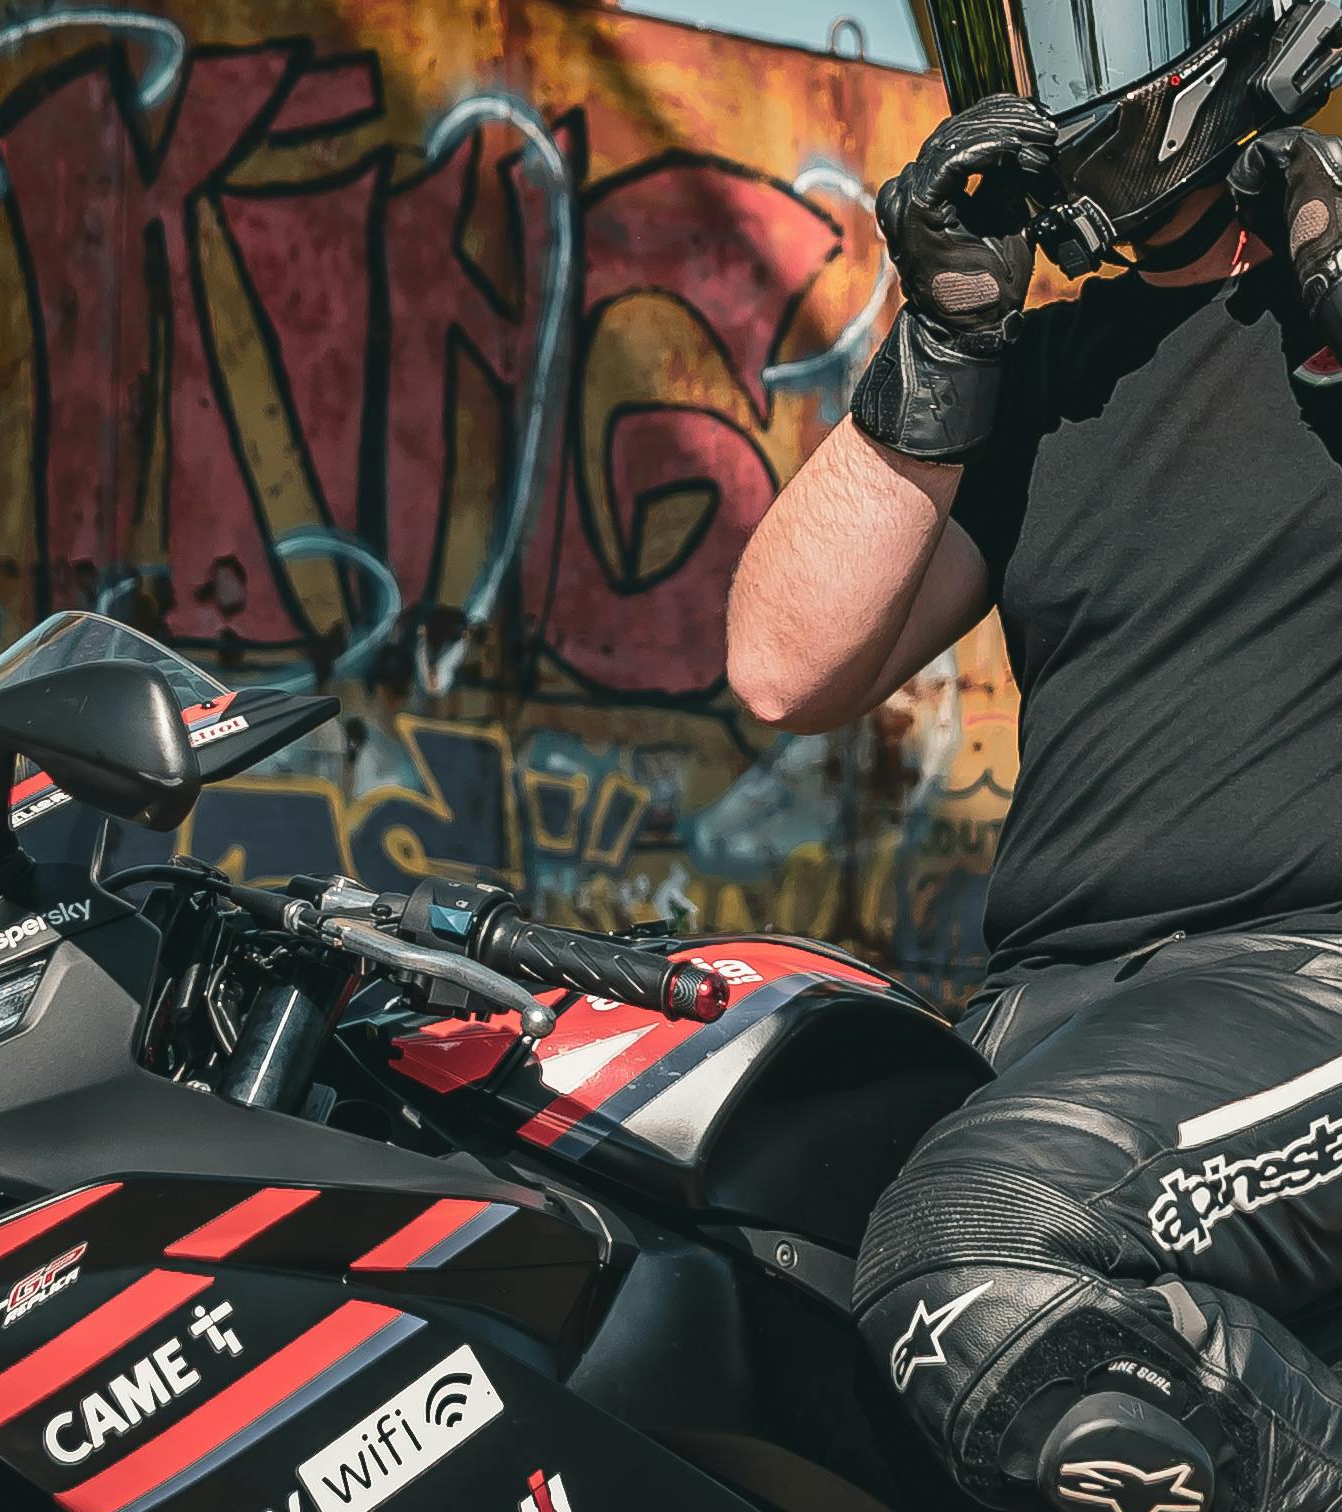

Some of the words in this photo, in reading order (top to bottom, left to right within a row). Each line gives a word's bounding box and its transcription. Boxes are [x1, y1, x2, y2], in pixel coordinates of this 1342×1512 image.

[2, 1266, 81, 1328] REPLICA
[43, 1340, 204, 1467] CAME
[323, 1406, 424, 1506] wifi
